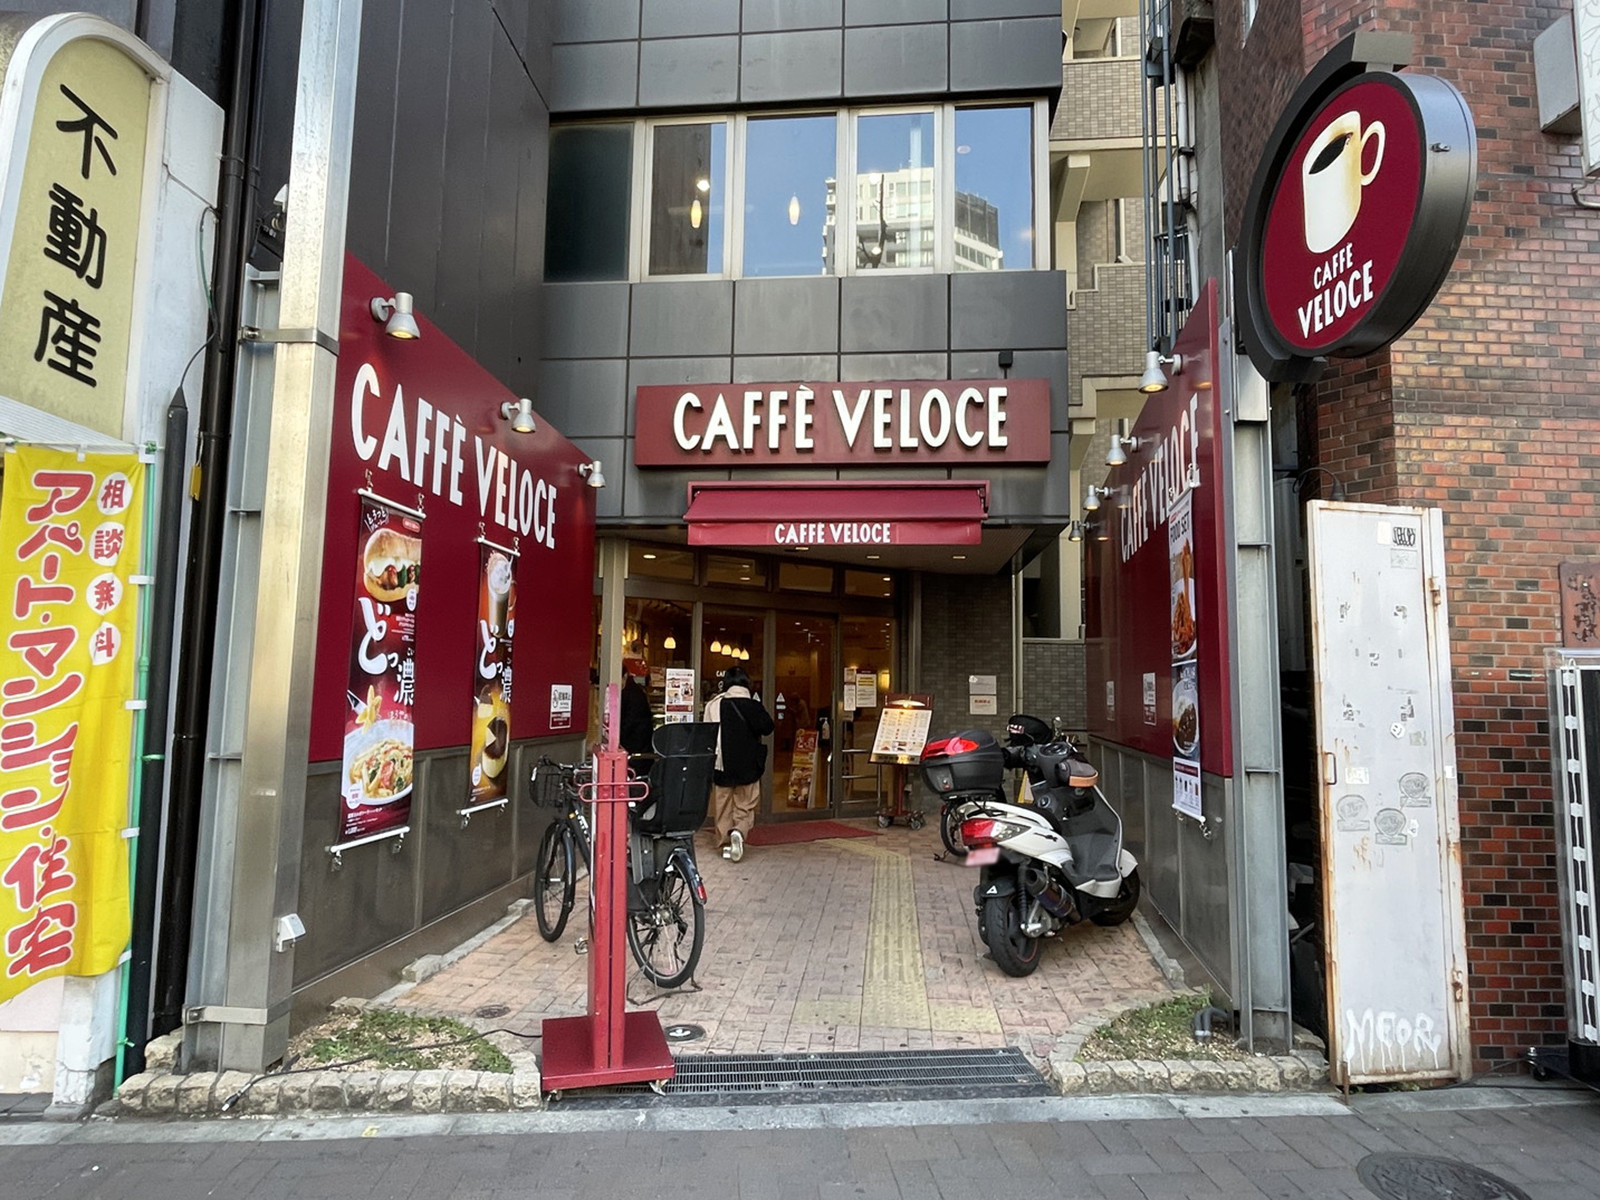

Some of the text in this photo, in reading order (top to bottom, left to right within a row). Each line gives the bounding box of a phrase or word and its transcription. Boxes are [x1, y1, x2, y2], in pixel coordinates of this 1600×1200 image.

[34, 83, 118, 388] 不動産
[1298, 259, 1374, 339] VELOCE
[352, 363, 557, 549] CAFFÈ VELOCE
[673, 384, 1009, 453] CAFFÈ VELOCE
[1149, 392, 1200, 531] VELOCE
[829, 522, 891, 544] VELOCE
